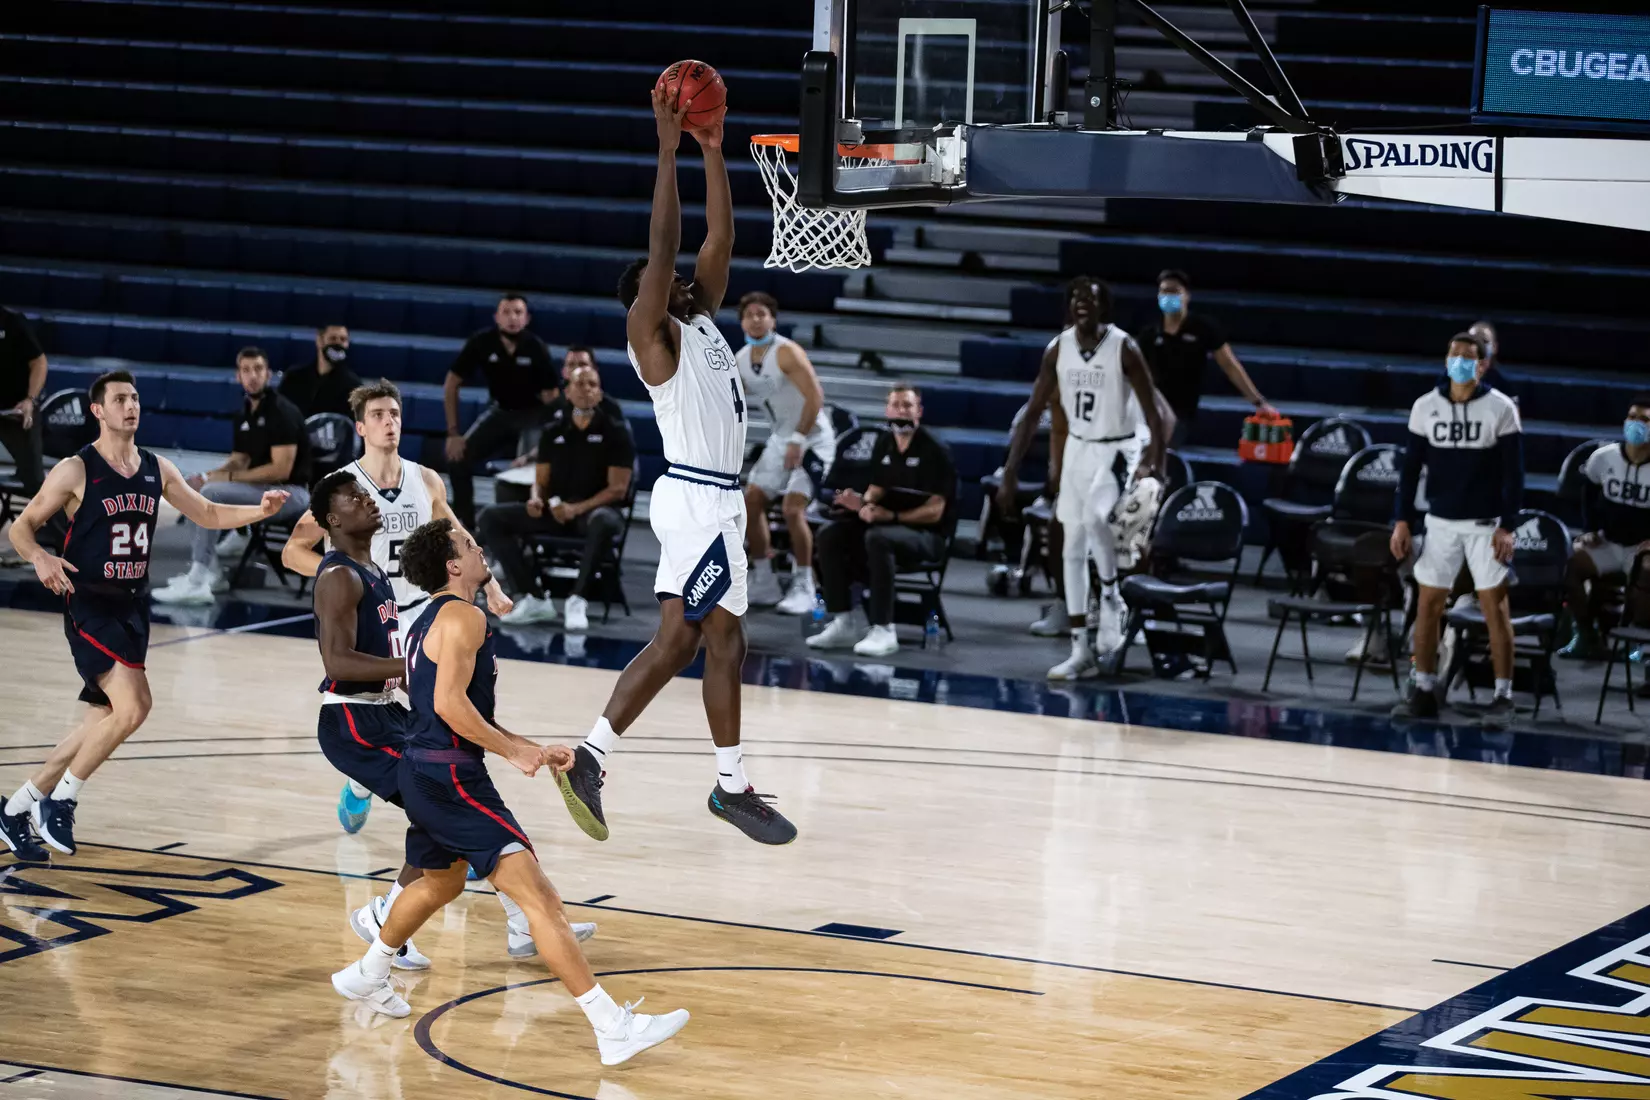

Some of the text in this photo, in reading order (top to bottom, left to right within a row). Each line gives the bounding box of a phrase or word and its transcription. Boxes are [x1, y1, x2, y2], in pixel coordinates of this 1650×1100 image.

[1345, 138, 1493, 174] SPALDING
[730, 377, 744, 423] 4
[1075, 390, 1095, 422] 12
[1433, 421, 1482, 442] CBU
[102, 493, 156, 516] DIXIE
[1608, 478, 1650, 503] CBU
[1176, 507, 1224, 522] adidas
[111, 522, 149, 556] 24
[687, 560, 724, 607] LANCERS
